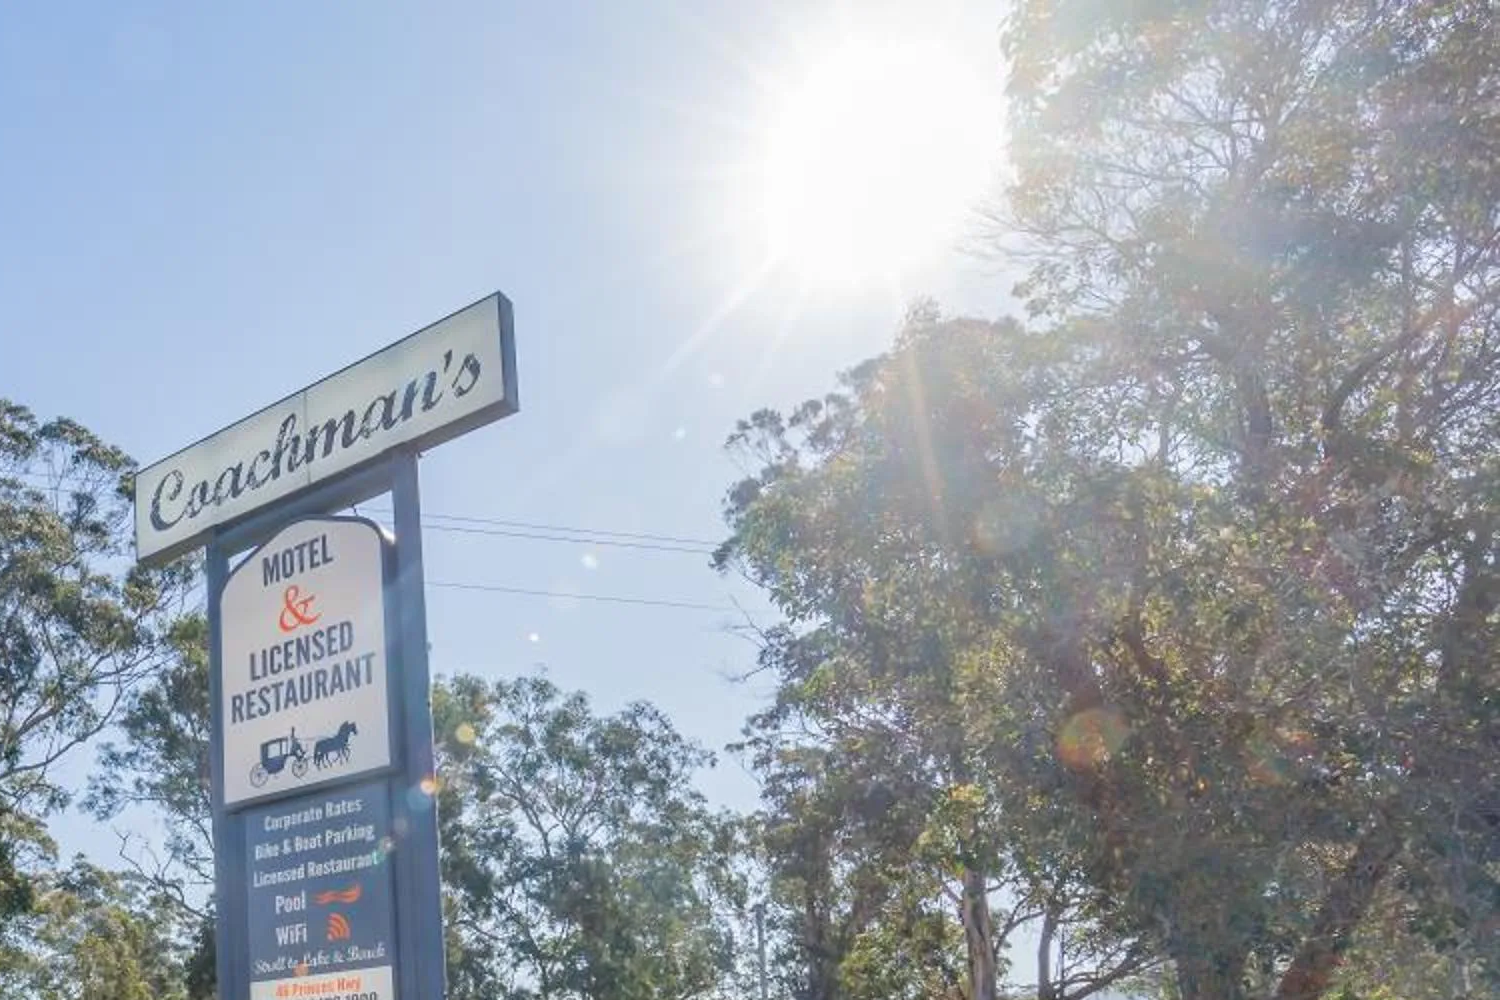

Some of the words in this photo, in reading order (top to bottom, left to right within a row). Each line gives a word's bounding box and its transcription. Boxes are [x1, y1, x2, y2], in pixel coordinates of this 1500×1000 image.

[150, 349, 482, 532] Coachman's
[262, 534, 334, 587] MOTEL
[279, 584, 322, 632] &
[250, 621, 354, 681] LICENSED
[231, 652, 377, 724] RESTAURANT
[263, 806, 323, 832] Corporate
[325, 798, 363, 818] Rates
[255, 843, 280, 861] Bike
[283, 838, 292, 855] &
[295, 833, 322, 852] Boat
[325, 822, 376, 846] Parking
[253, 862, 305, 888] Licensed
[307, 849, 379, 879] Restaurant
[275, 889, 306, 915] Pool
[276, 922, 308, 947] WiFi
[337, 976, 361, 994] Hwy
